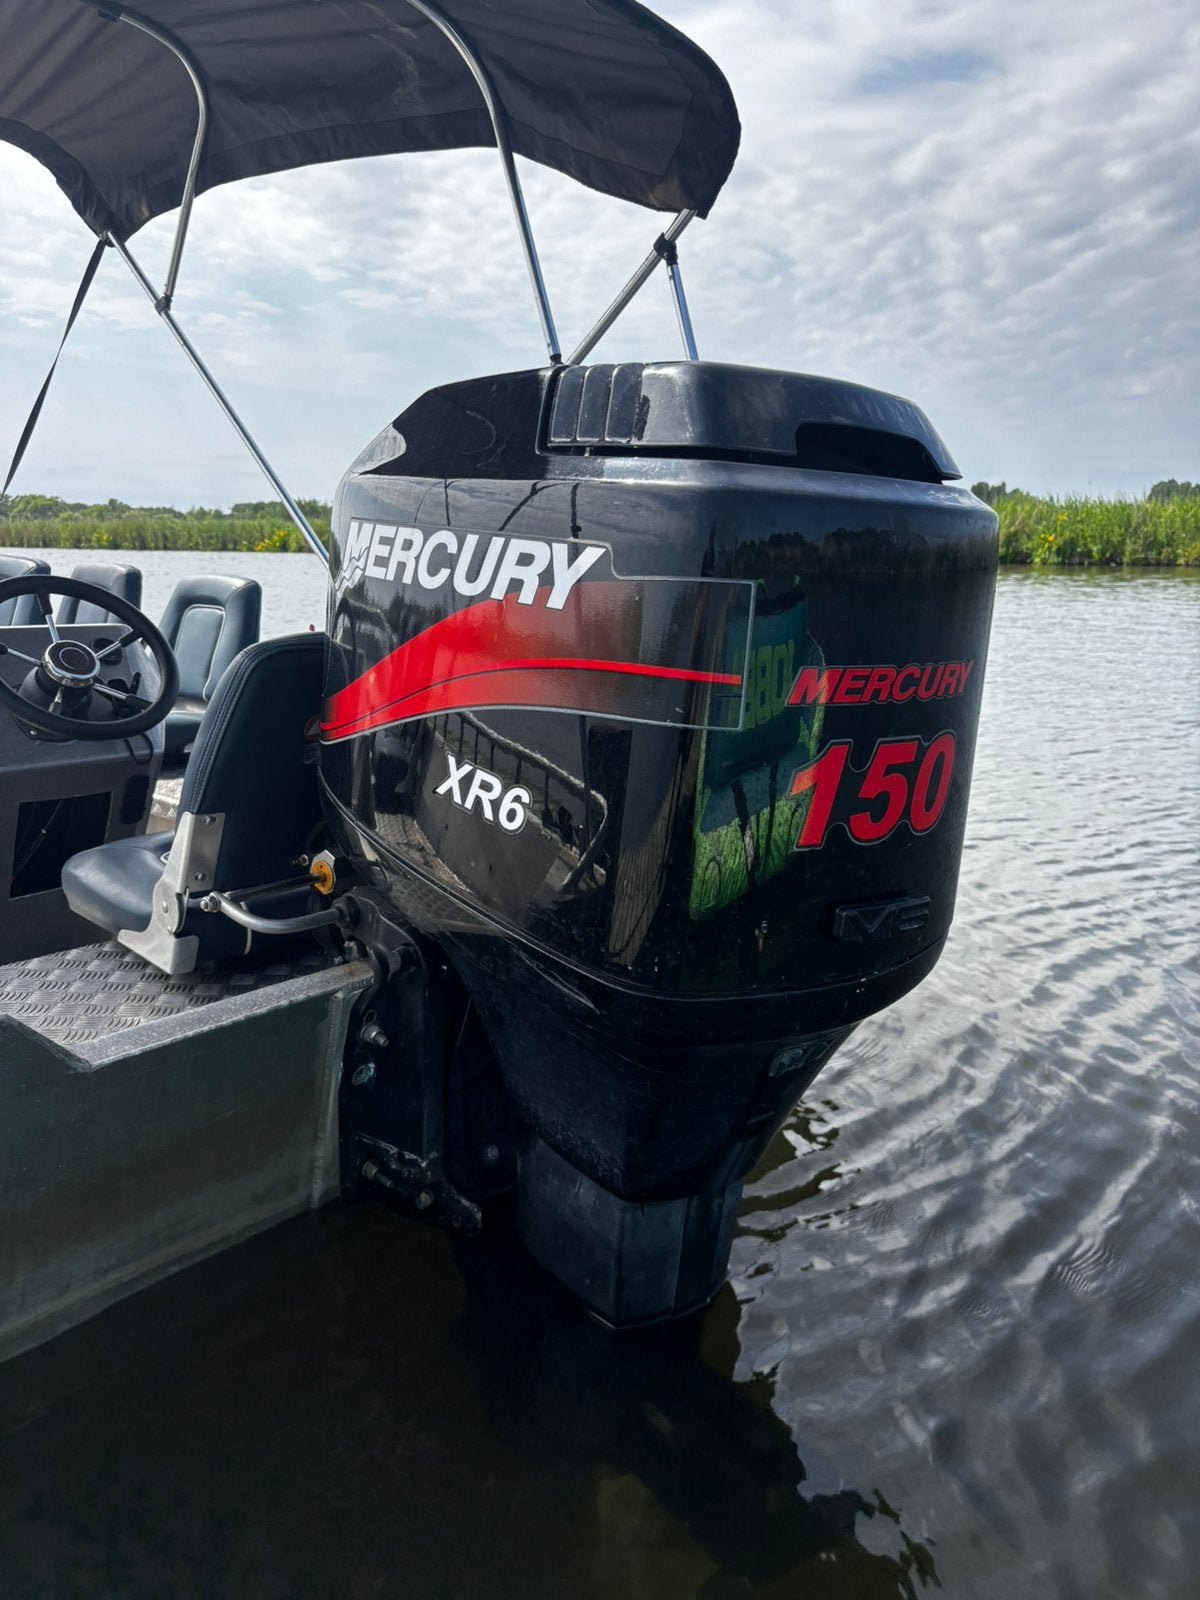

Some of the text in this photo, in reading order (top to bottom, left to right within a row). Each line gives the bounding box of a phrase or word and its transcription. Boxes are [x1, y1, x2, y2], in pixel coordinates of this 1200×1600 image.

[337, 521, 606, 610] MERCURY
[786, 661, 974, 705] MERCURY
[435, 754, 531, 832] XR6
[789, 733, 956, 847] 150
